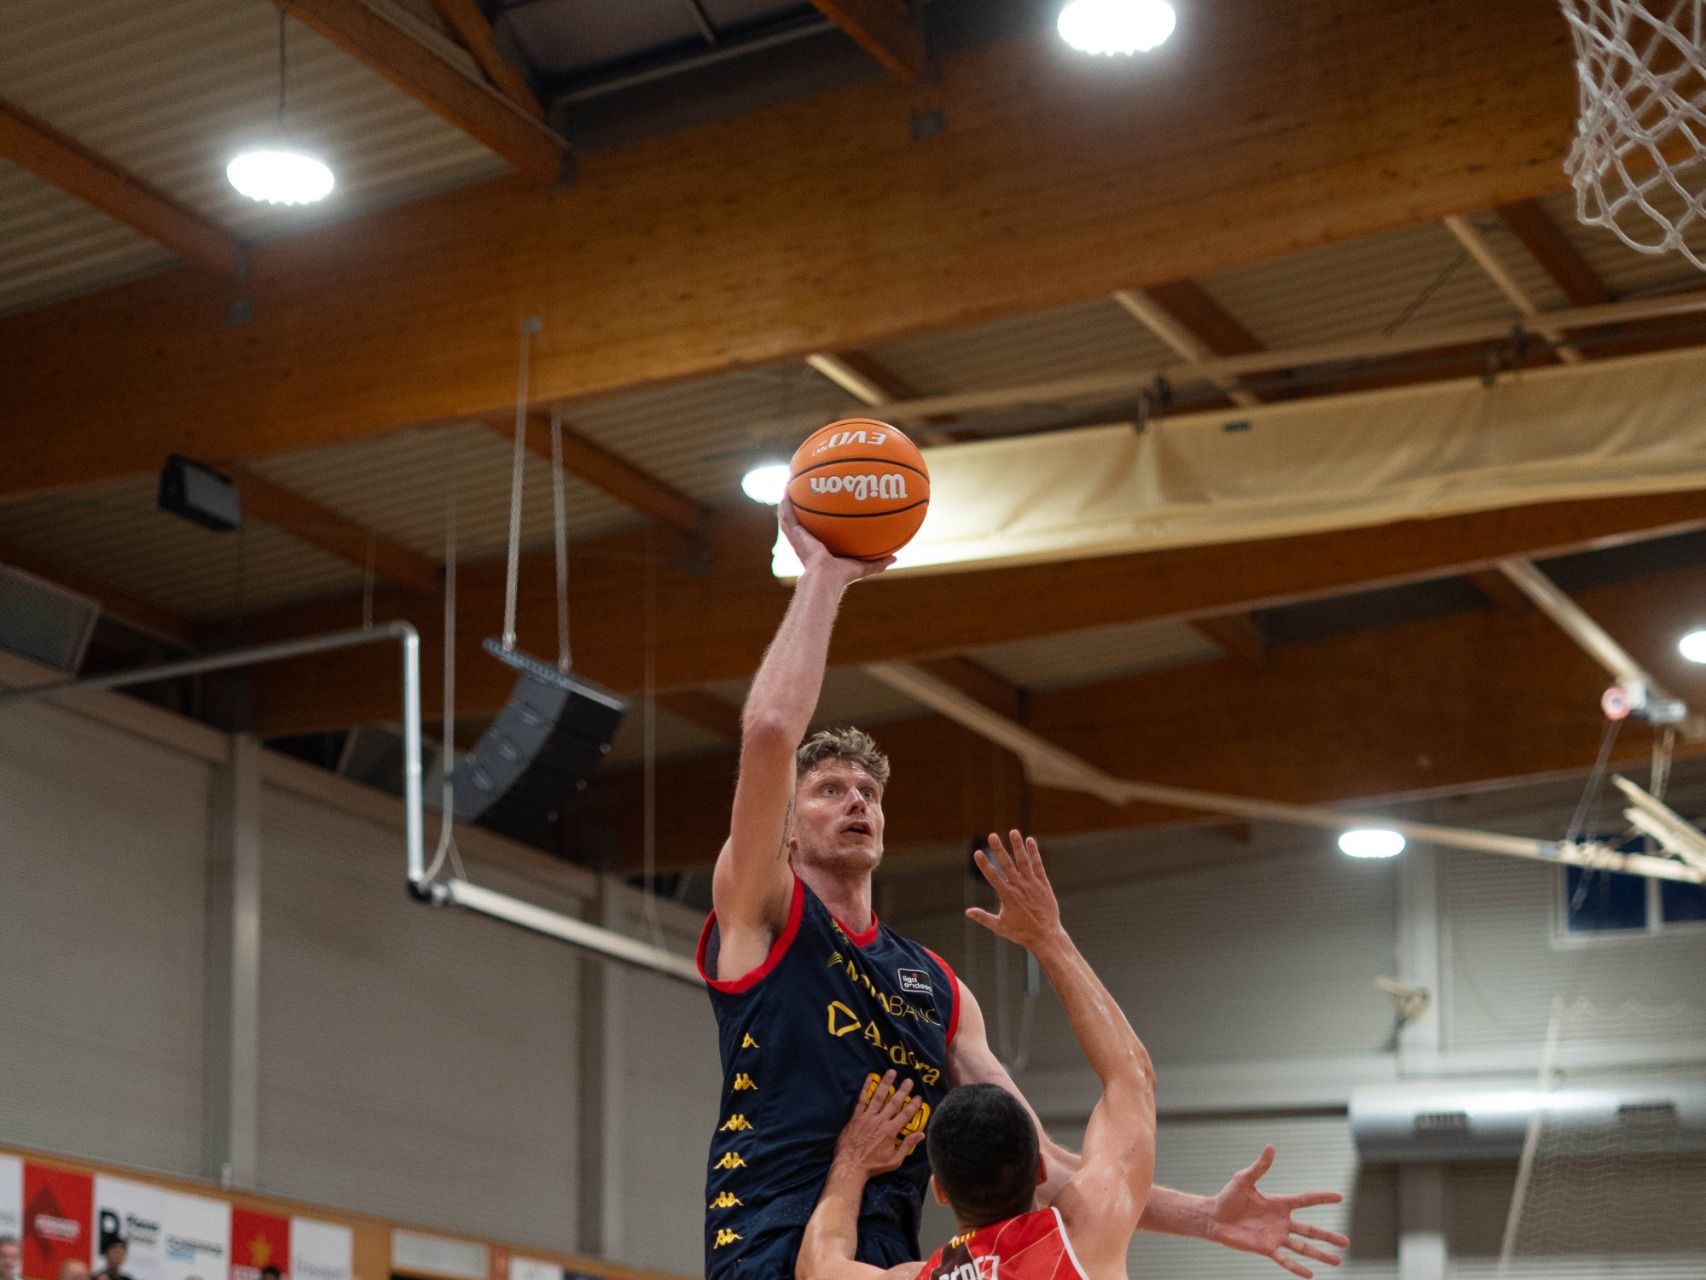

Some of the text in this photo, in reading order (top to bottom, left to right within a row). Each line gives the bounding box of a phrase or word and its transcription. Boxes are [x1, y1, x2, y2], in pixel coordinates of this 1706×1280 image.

[828, 430, 887, 448] EVO
[809, 473, 908, 501] Wilson
[902, 975, 918, 984] liga
